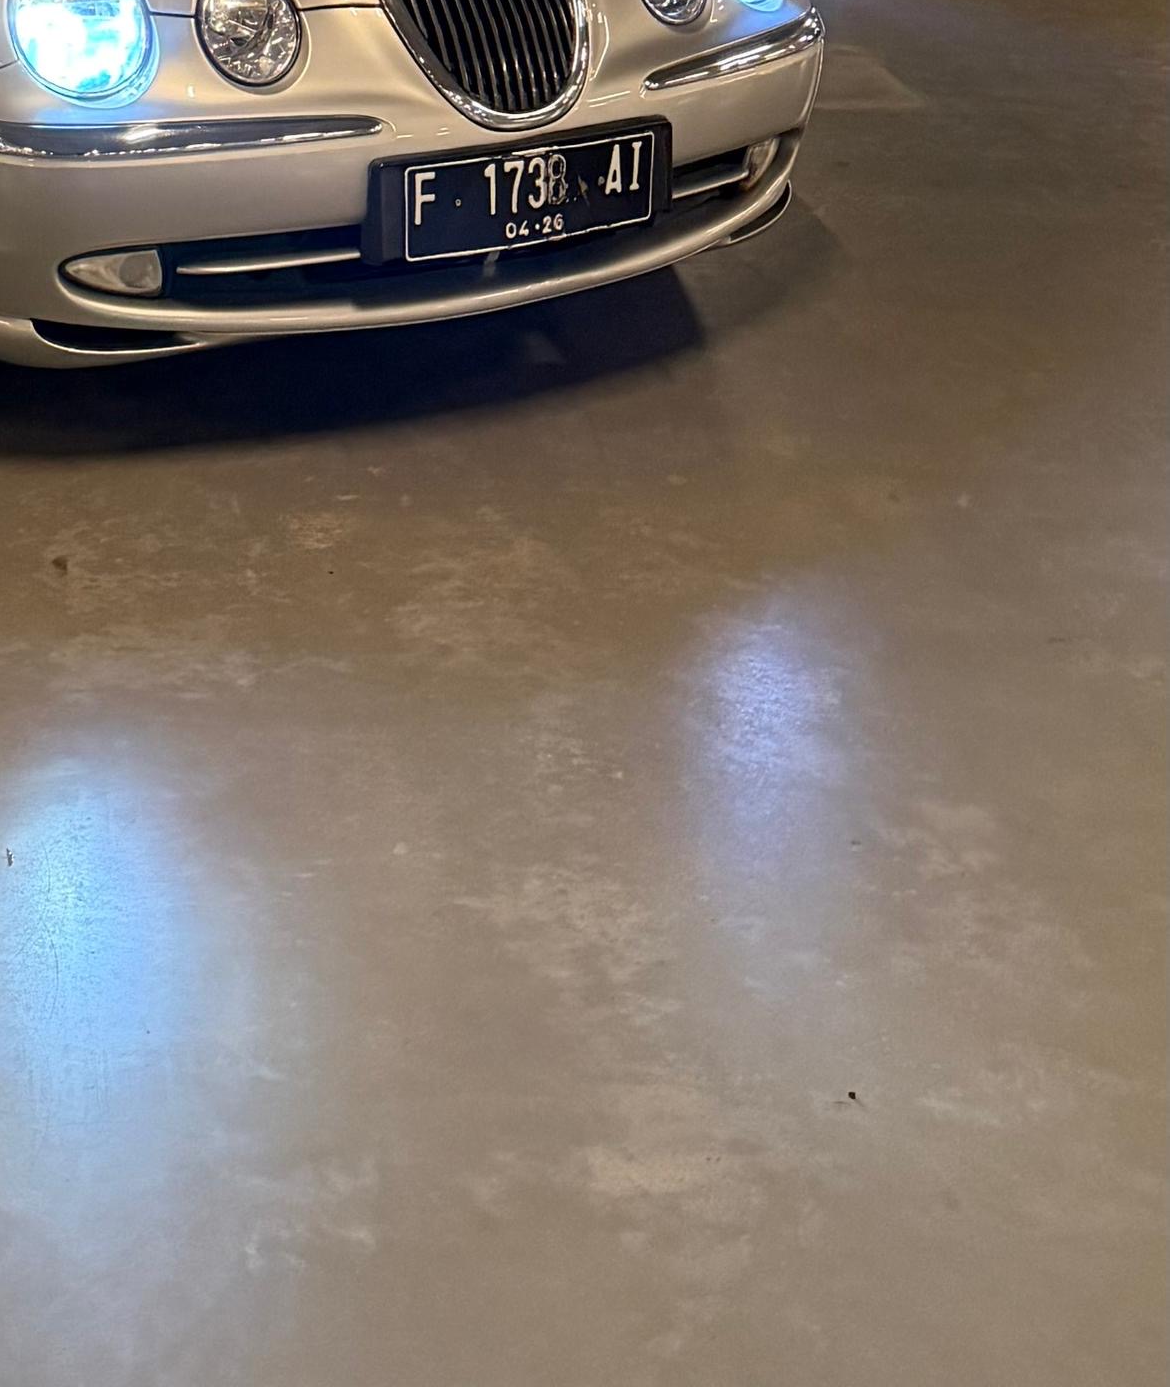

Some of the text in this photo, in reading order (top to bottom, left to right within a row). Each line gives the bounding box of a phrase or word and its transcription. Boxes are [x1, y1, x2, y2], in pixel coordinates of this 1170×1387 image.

[414, 141, 643, 226] F 1738 AI
